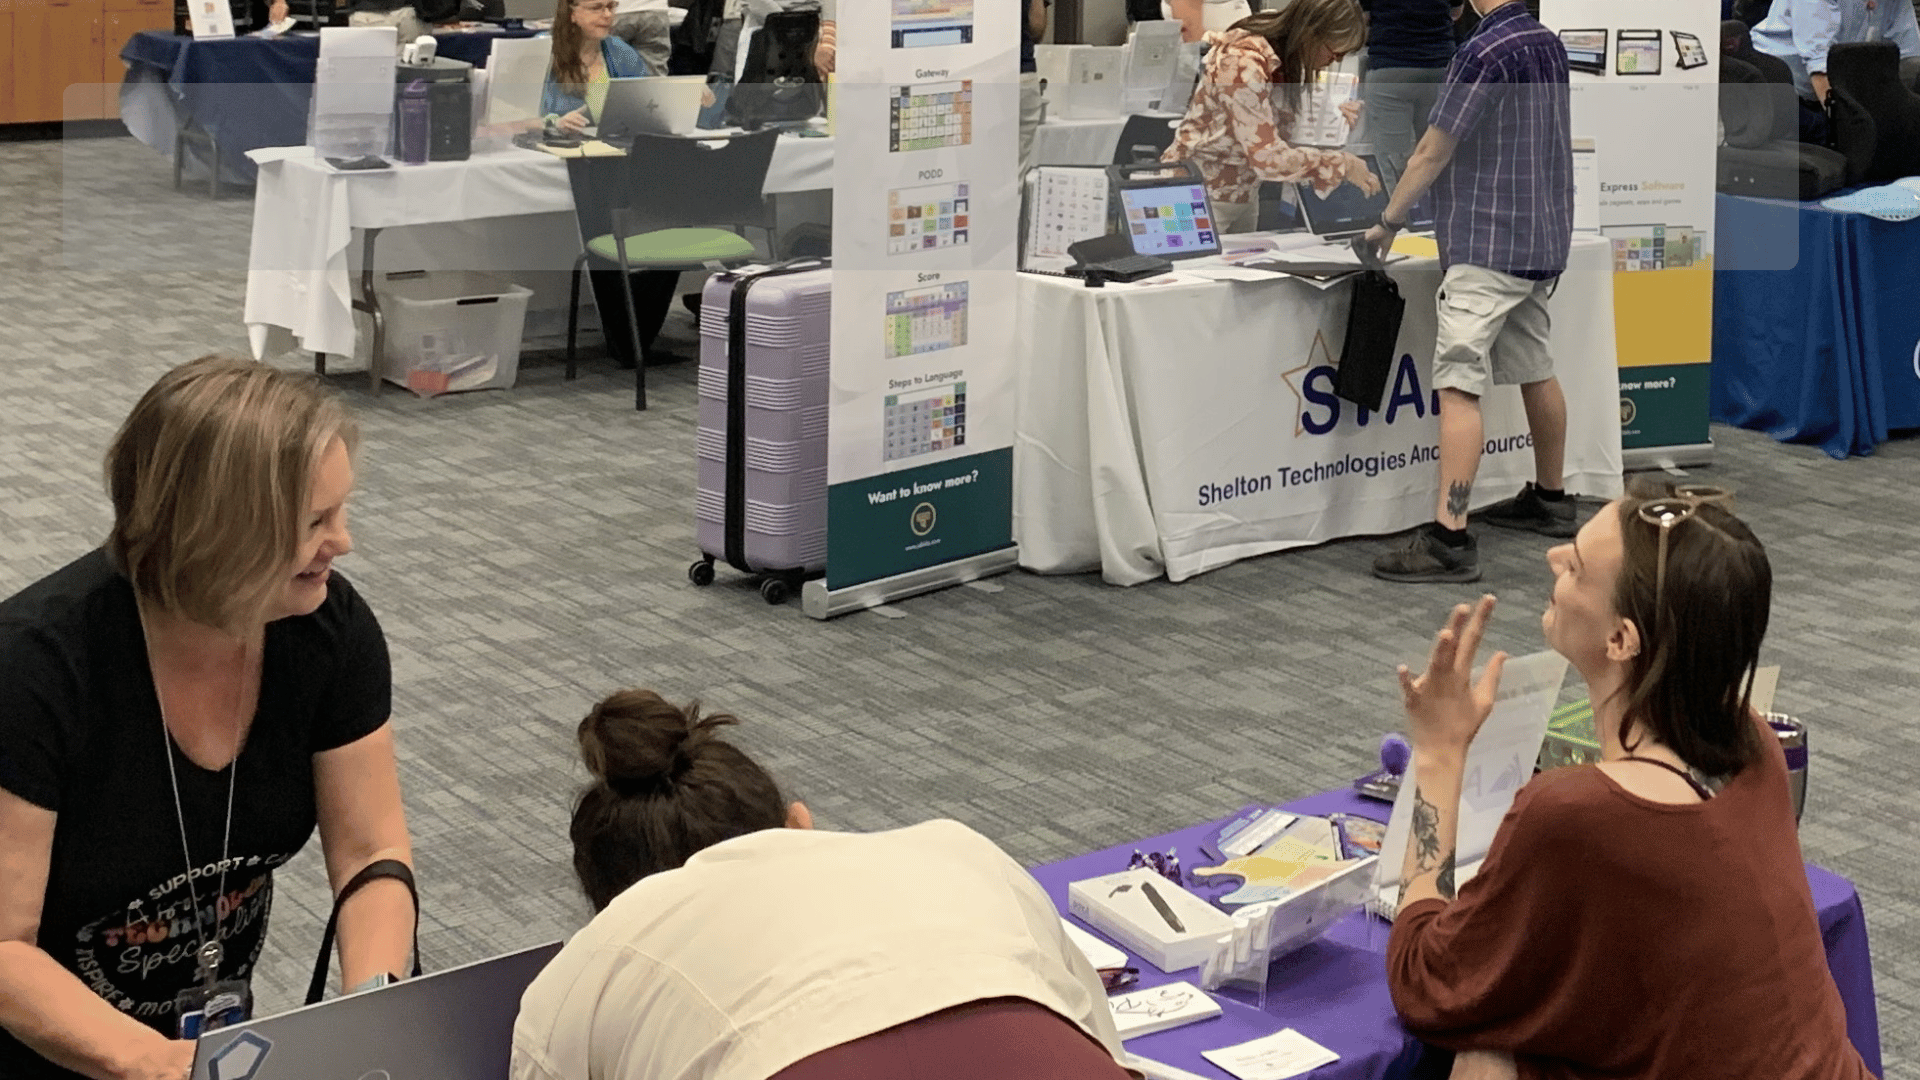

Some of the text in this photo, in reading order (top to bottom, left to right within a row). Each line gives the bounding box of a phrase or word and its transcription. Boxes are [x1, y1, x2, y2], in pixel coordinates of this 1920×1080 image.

[915, 68, 949, 79] Gateway
[918, 168, 943, 180] PODD
[1600, 181, 1685, 194] Express Software
[918, 272, 940, 283] Score
[888, 369, 964, 389] Steps to Language
[1619, 376, 1676, 391] now more?
[1302, 353, 1441, 435] SA
[868, 469, 979, 505] Want to know more?
[1199, 475, 1271, 506] Shelton
[1278, 451, 1406, 488] Technologies
[149, 856, 245, 900] SUPPORT
